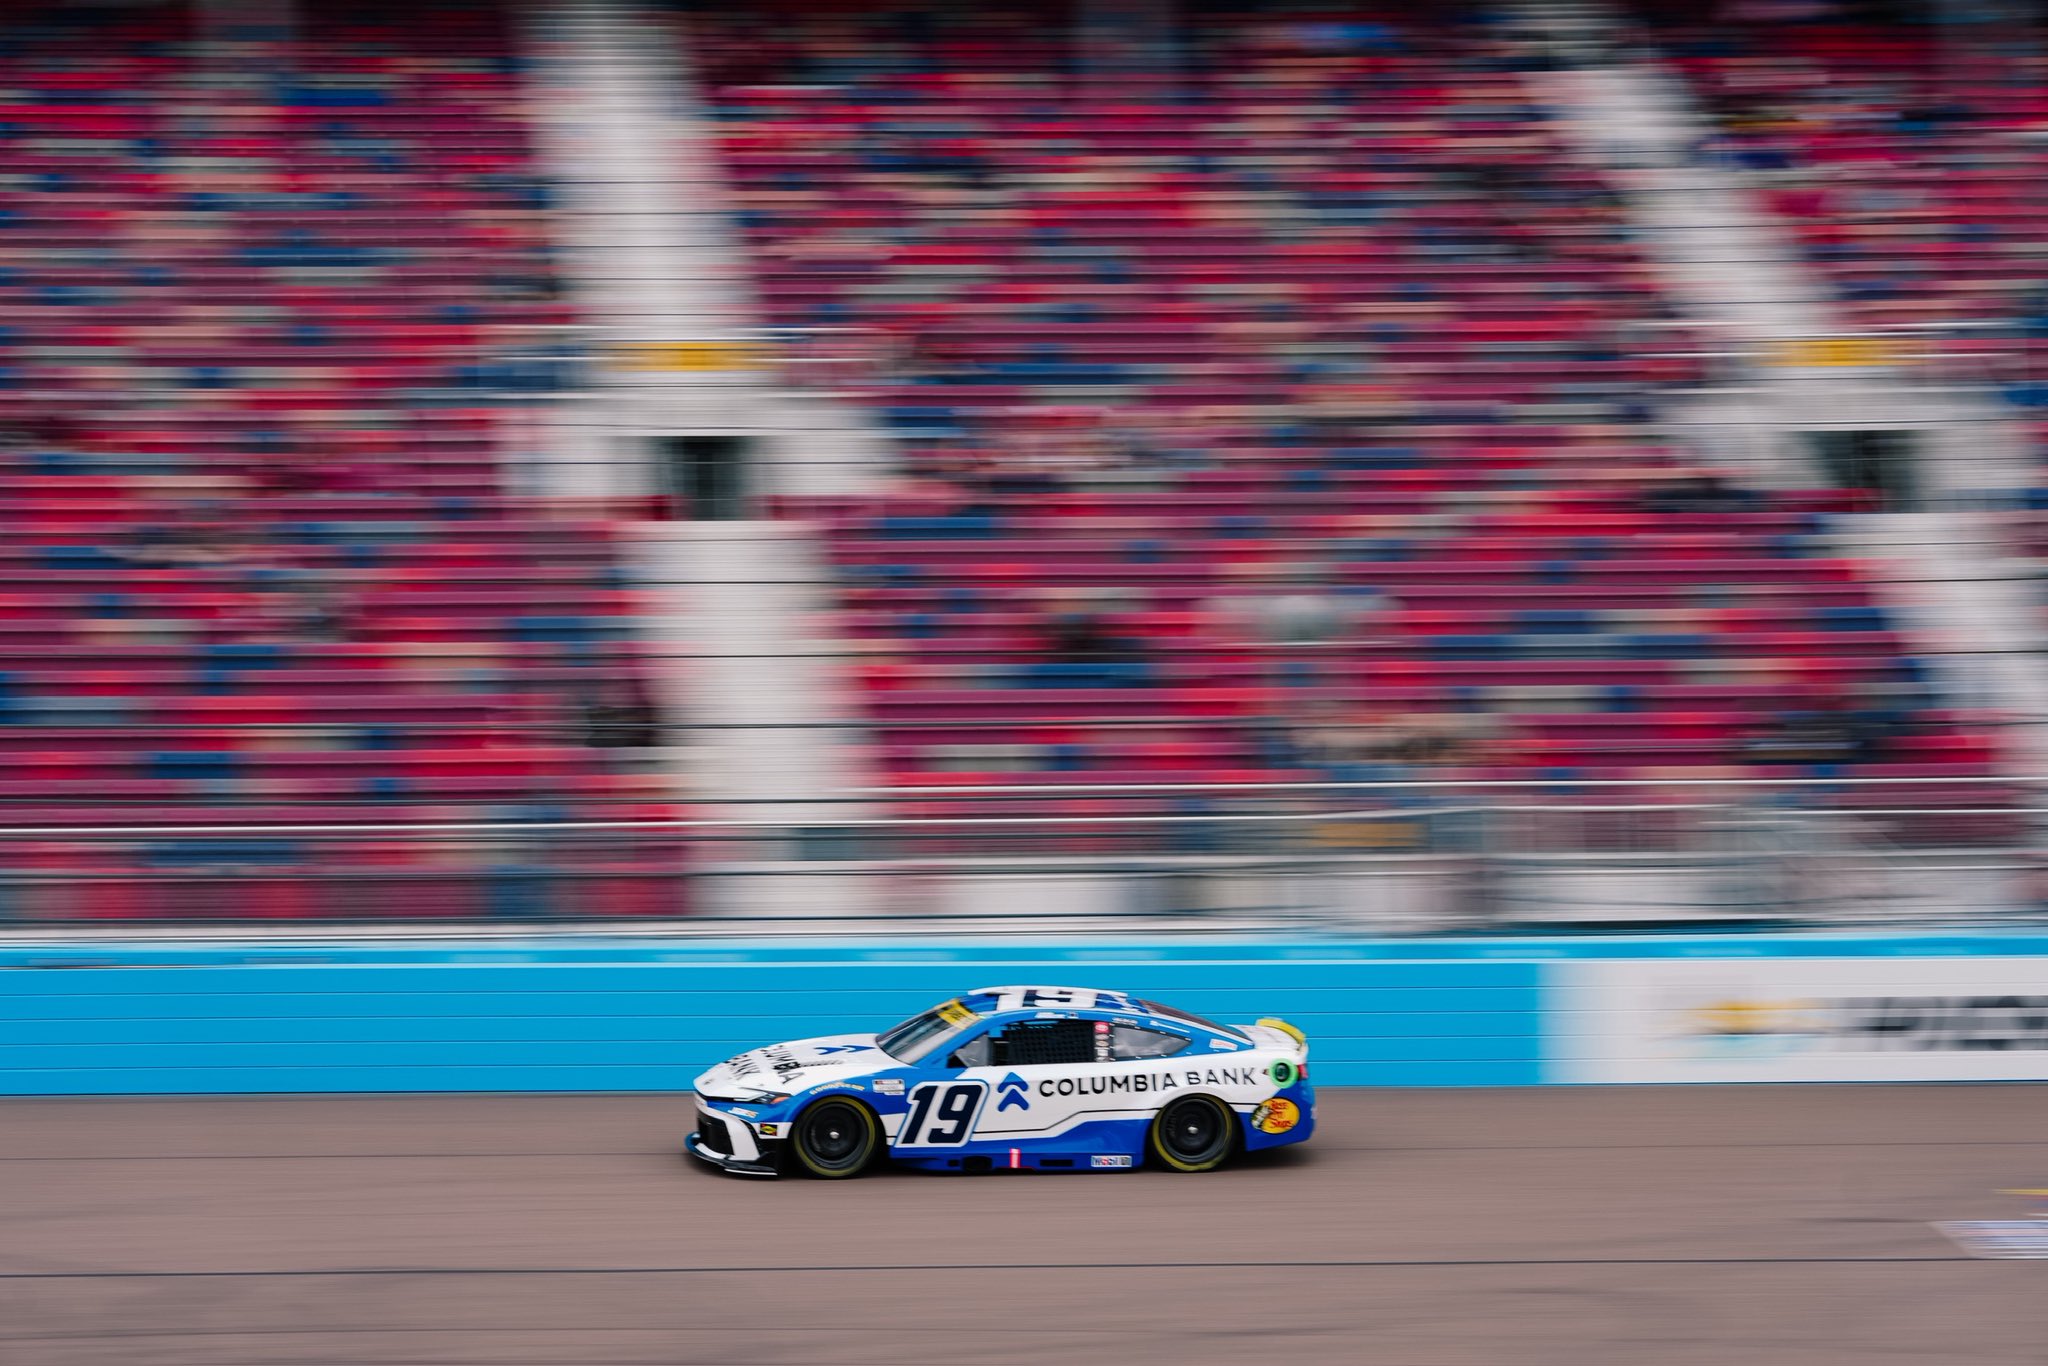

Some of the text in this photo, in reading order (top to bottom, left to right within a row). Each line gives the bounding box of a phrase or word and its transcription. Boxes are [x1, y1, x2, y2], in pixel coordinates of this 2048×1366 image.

[1039, 1067, 1258, 1097] COLUMBIA BANK
[901, 1084, 983, 1145] 19
